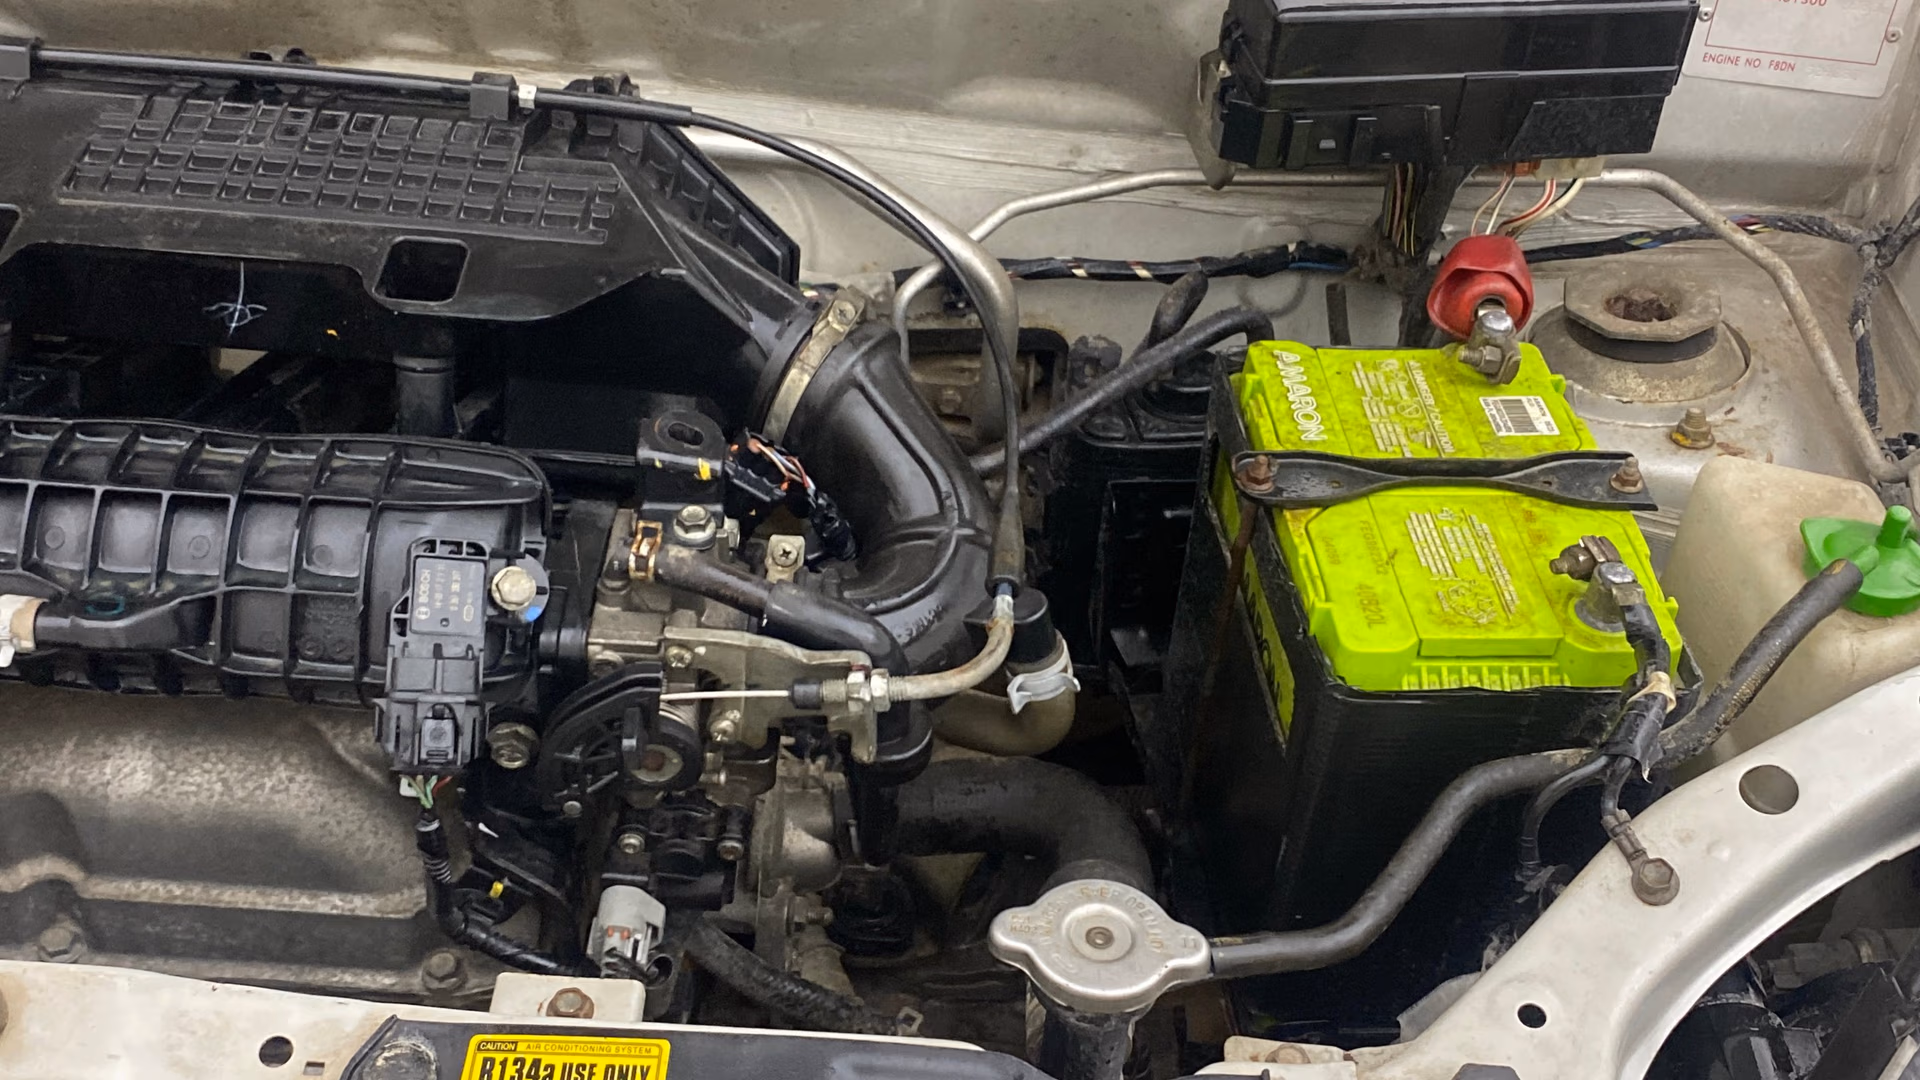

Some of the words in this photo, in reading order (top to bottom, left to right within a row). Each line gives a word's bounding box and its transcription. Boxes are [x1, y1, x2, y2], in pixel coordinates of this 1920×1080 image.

[1702, 52, 1741, 67] ENGINE
[1744, 58, 1762, 69] NO
[1768, 59, 1796, 73] F8DN
[1273, 350, 1330, 442] AMARON
[1430, 412, 1457, 453] CAUTION
[418, 568, 431, 604] BOSCH
[1355, 582, 1386, 629] 40B20L
[480, 1042, 516, 1051] CAUTION
[525, 1043, 541, 1051] AIR
[544, 1044, 612, 1053] CONDITIONING
[615, 1046, 652, 1055] SYSTEM
[477, 1056, 556, 1080] R134a
[559, 1062, 598, 1080] USE
[602, 1064, 651, 1080] ONLY
